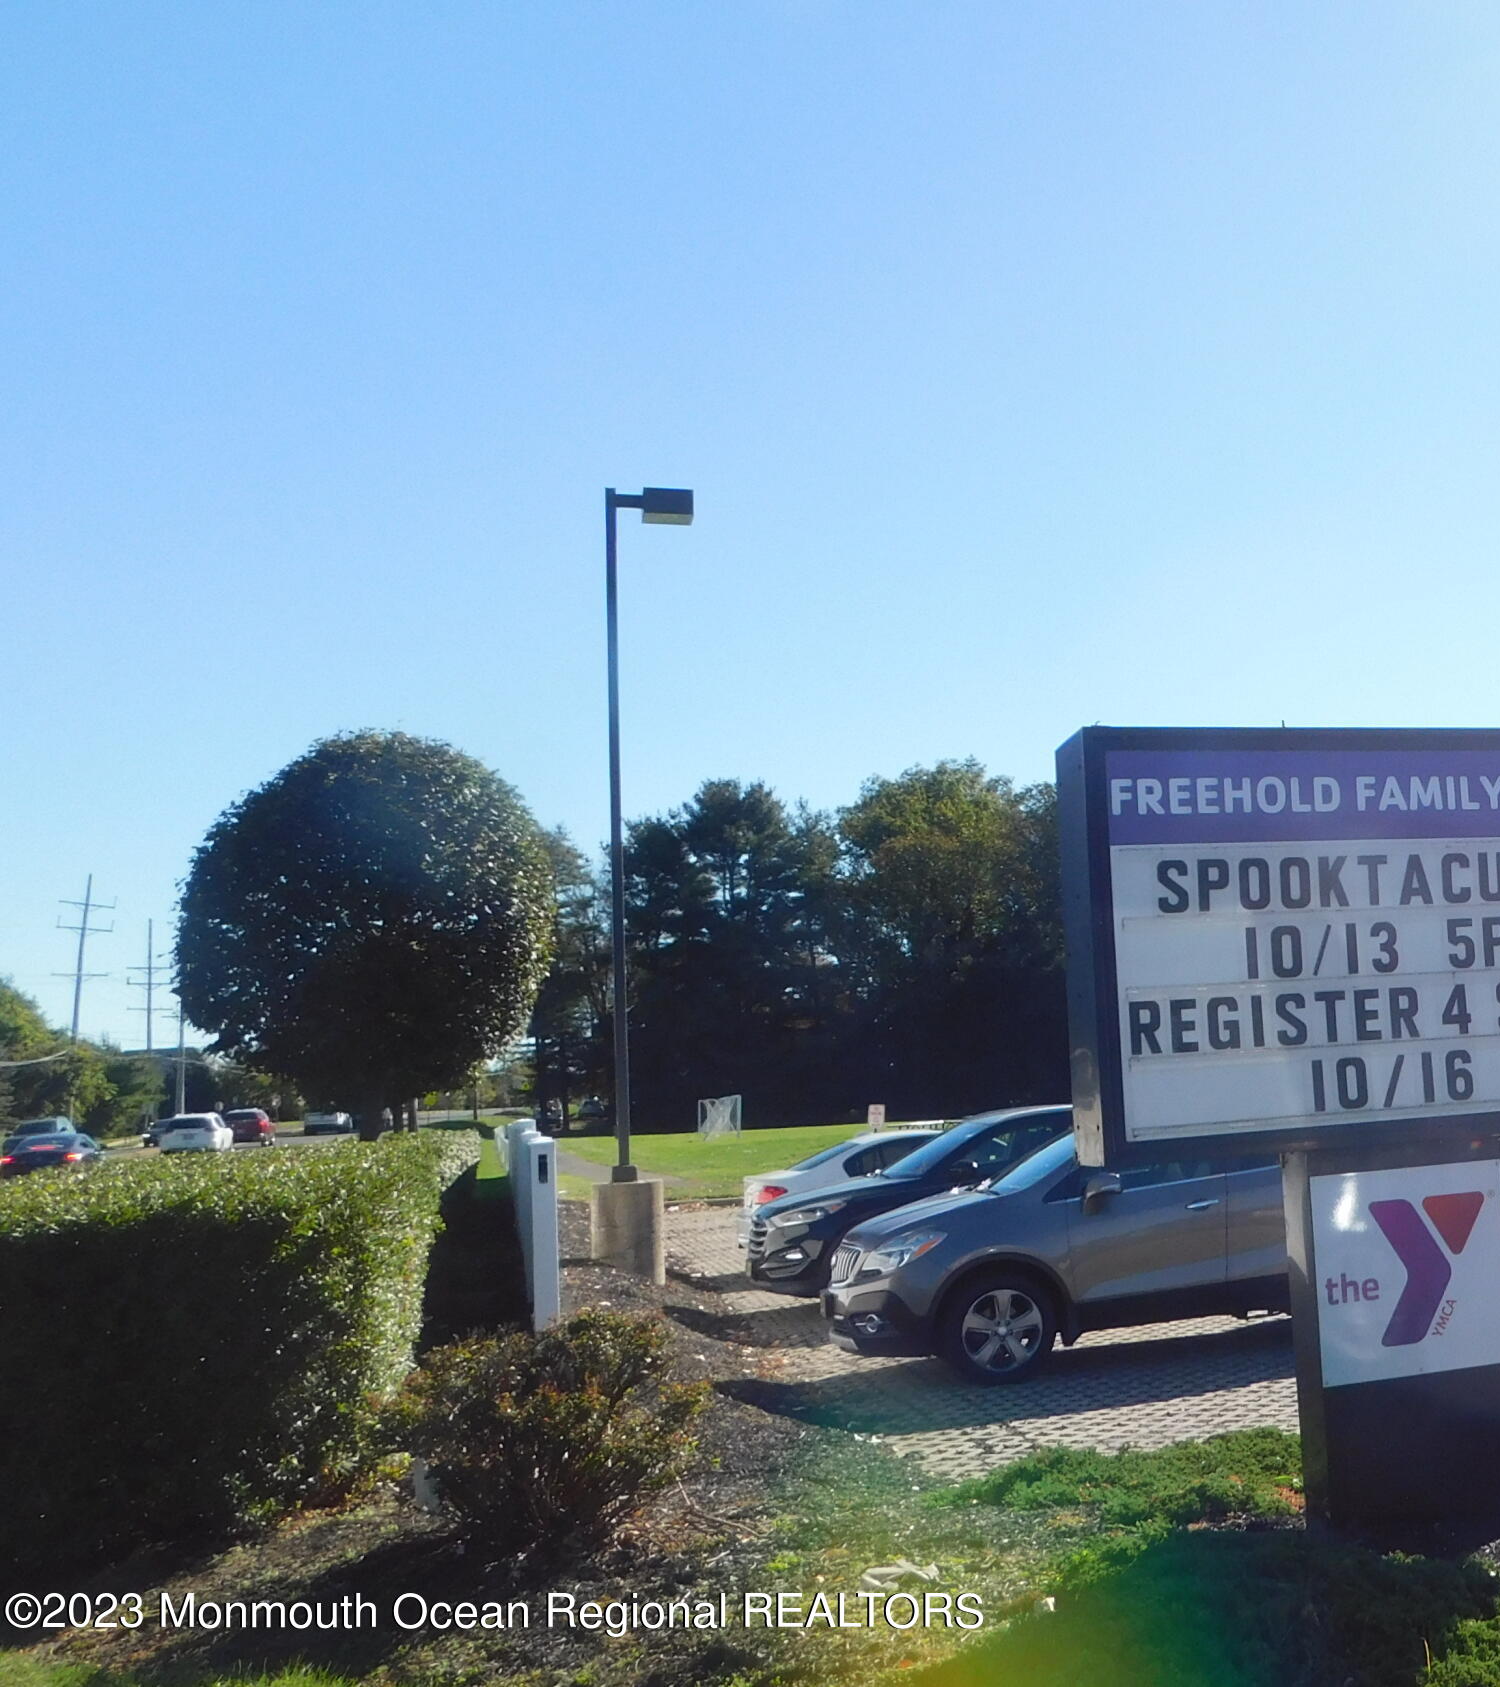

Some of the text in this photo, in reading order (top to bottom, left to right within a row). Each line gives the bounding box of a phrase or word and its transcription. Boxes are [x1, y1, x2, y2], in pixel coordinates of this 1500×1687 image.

[1110, 776, 1341, 815] FREEHOLD
[1245, 921, 1399, 979] 10/13
[1130, 987, 1419, 1054] REGISTER
[1442, 983, 1472, 1034] 4
[1311, 1049, 1474, 1112] 10/16
[1325, 1273, 1380, 1306] the
[1431, 1299, 1457, 1338] YMCA
